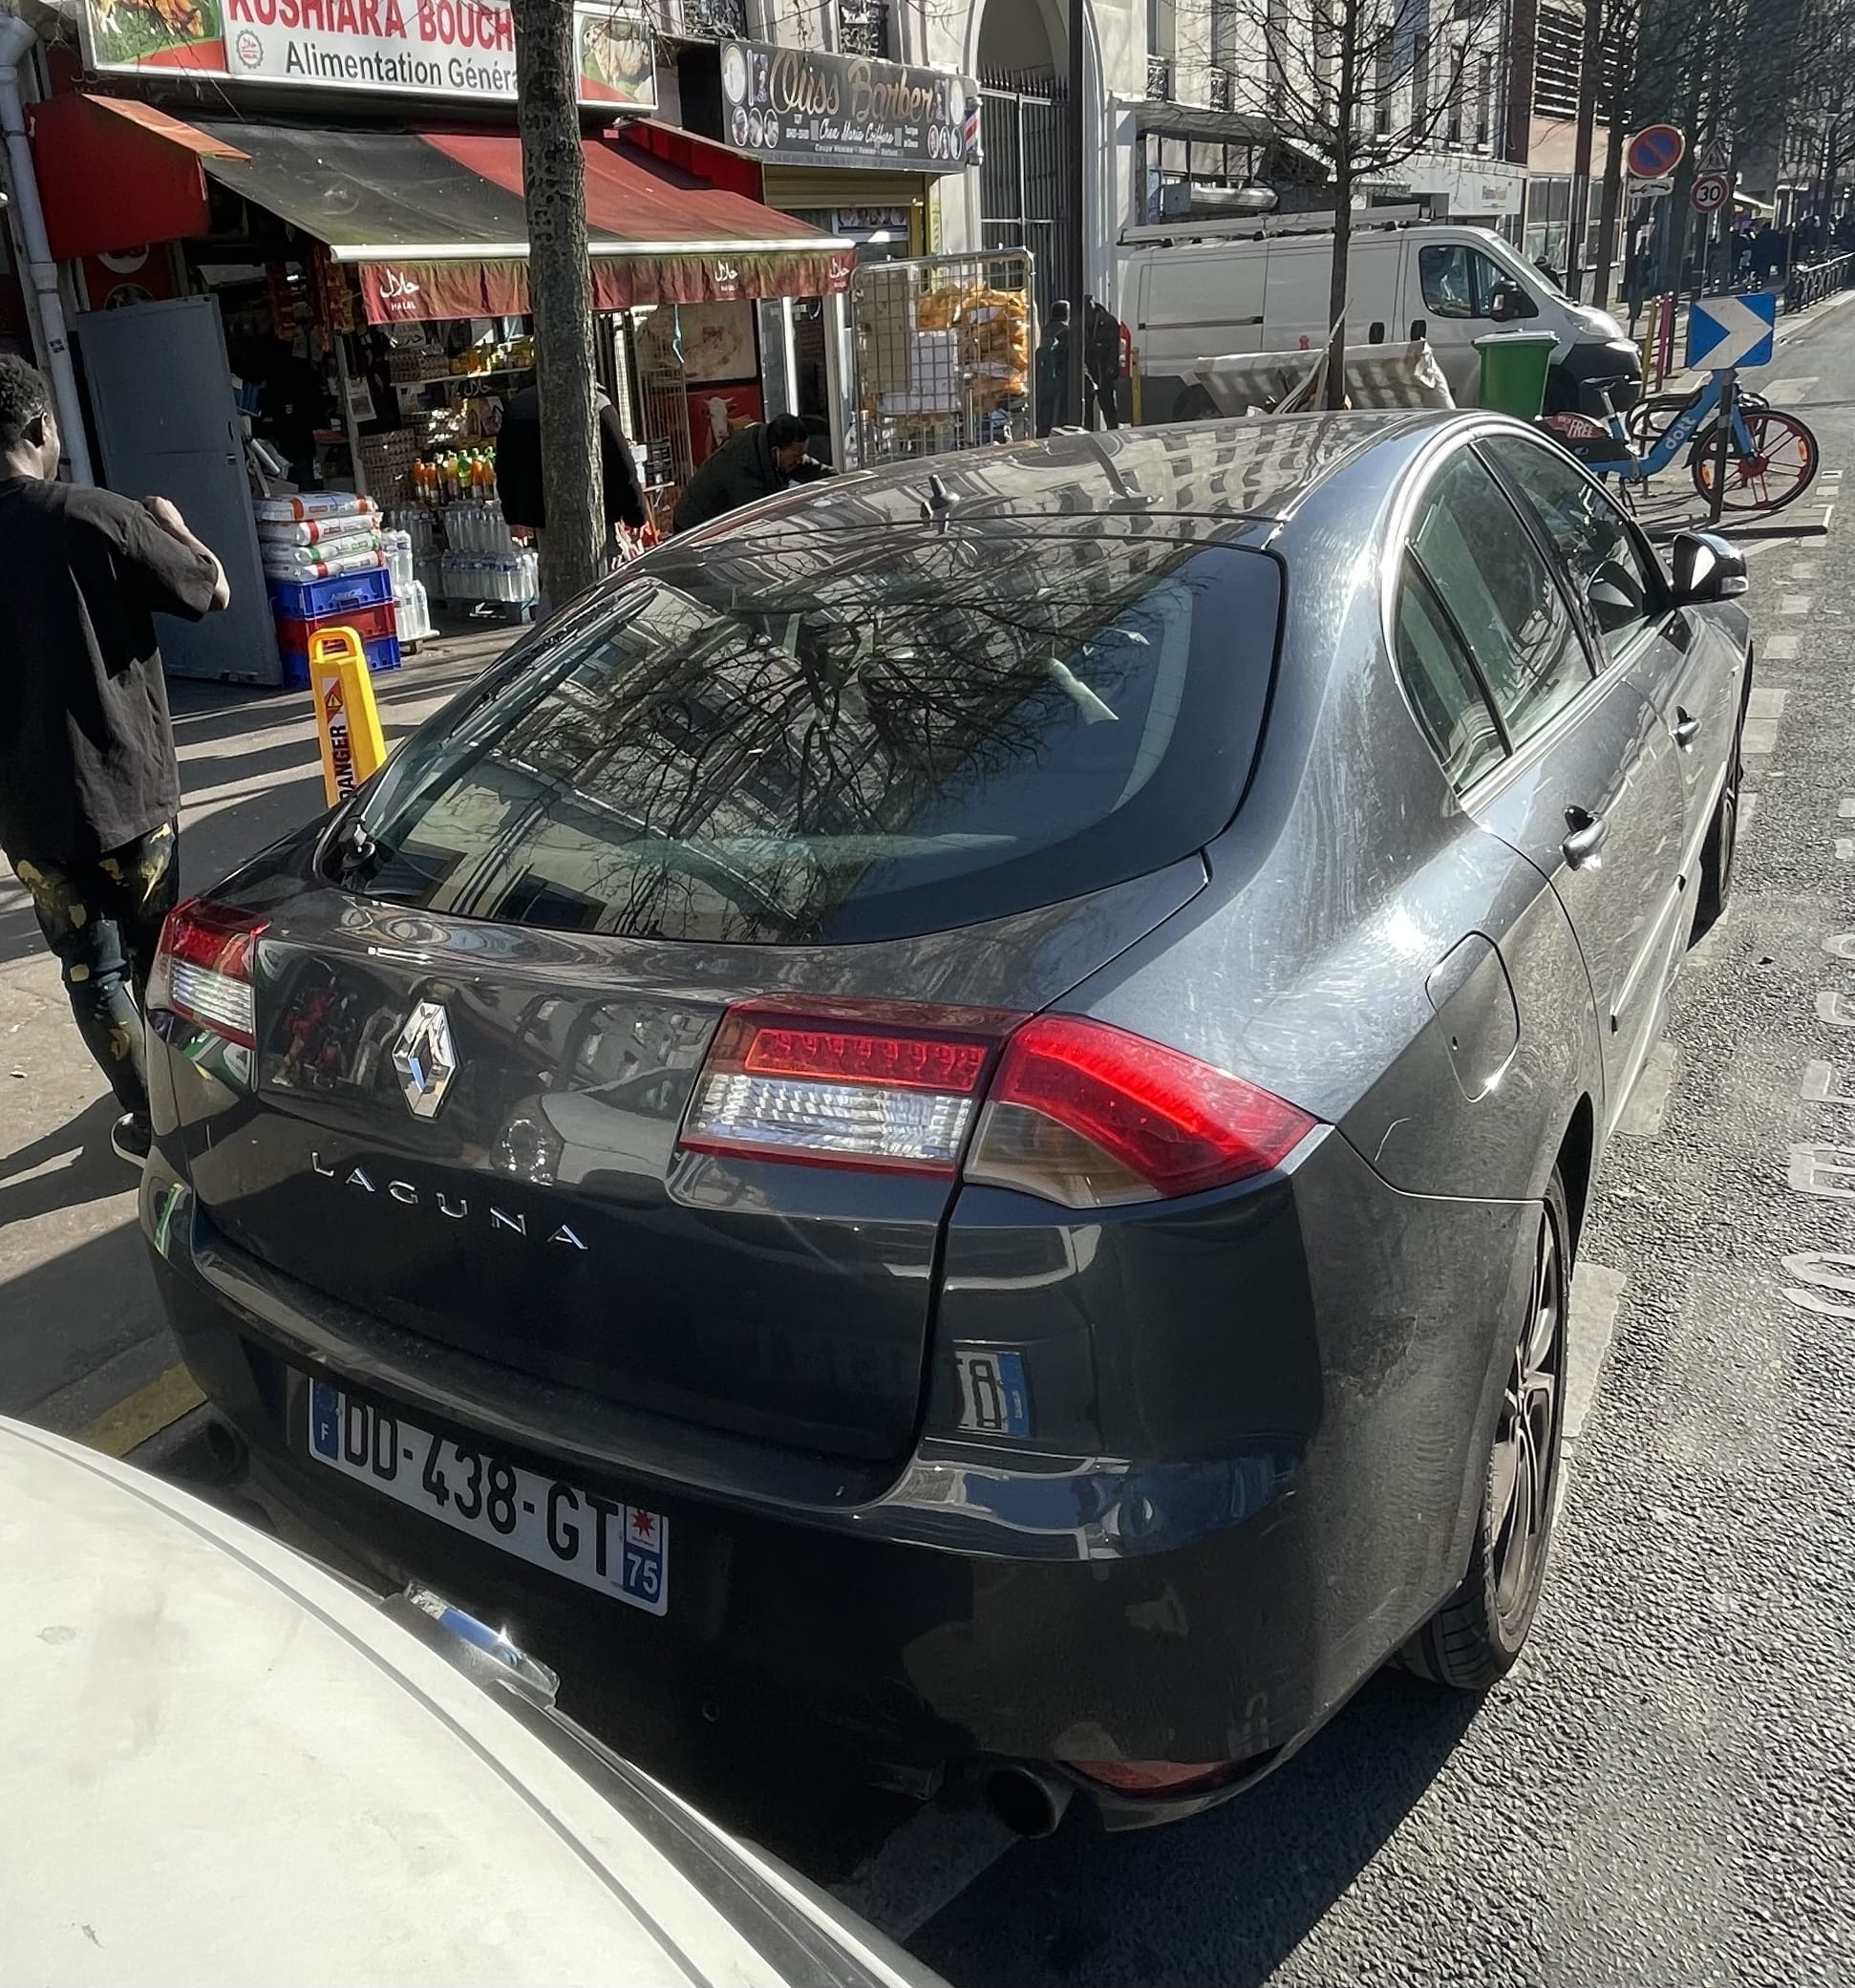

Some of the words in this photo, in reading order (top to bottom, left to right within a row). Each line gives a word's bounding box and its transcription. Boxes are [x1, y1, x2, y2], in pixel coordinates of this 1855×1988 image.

[286, 41, 442, 85] Alimentation
[847, 59, 934, 123] Barber
[864, 121, 894, 148] Coiffure
[1698, 185, 1720, 202] 30
[714, 259, 738, 283] حلال
[828, 257, 850, 278] حلال
[379, 267, 420, 298] حلال
[391, 301, 416, 310] HALAL
[1567, 418, 1593, 438] FREE
[1665, 416, 1696, 450] dott
[311, 1151, 588, 1251] LAGUNA
[321, 1422, 330, 1441] F
[345, 1394, 619, 1576] DD-438-GT
[627, 1552, 658, 1595] 75
